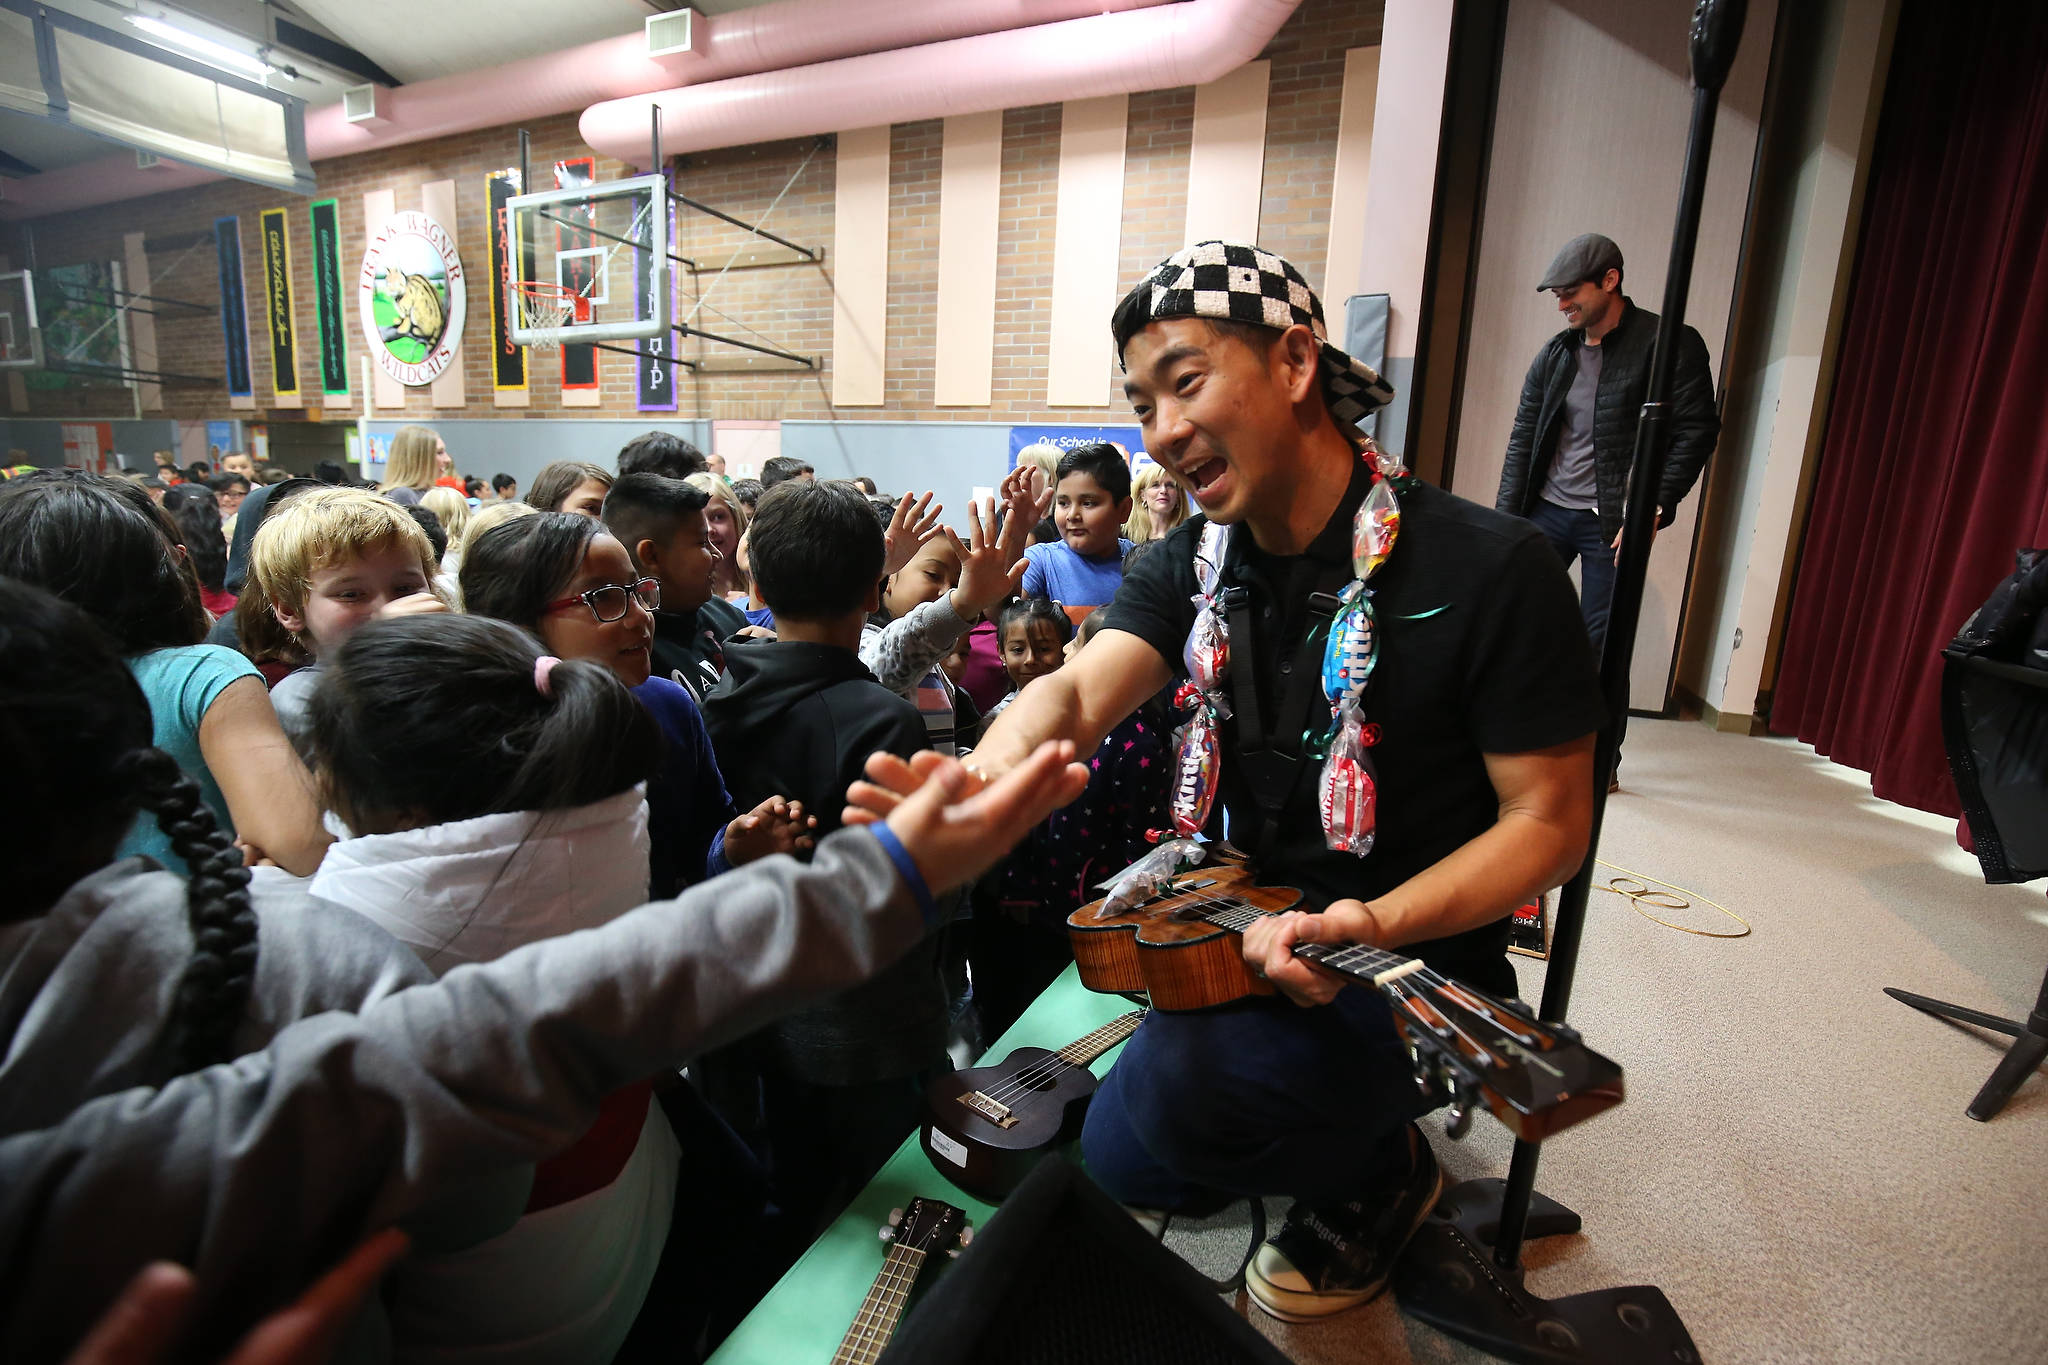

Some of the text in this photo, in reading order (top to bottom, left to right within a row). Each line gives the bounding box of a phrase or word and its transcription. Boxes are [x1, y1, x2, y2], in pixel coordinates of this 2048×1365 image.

[381, 345, 451, 383] WILDCATS
[1038, 436, 1106, 448] Our School is
